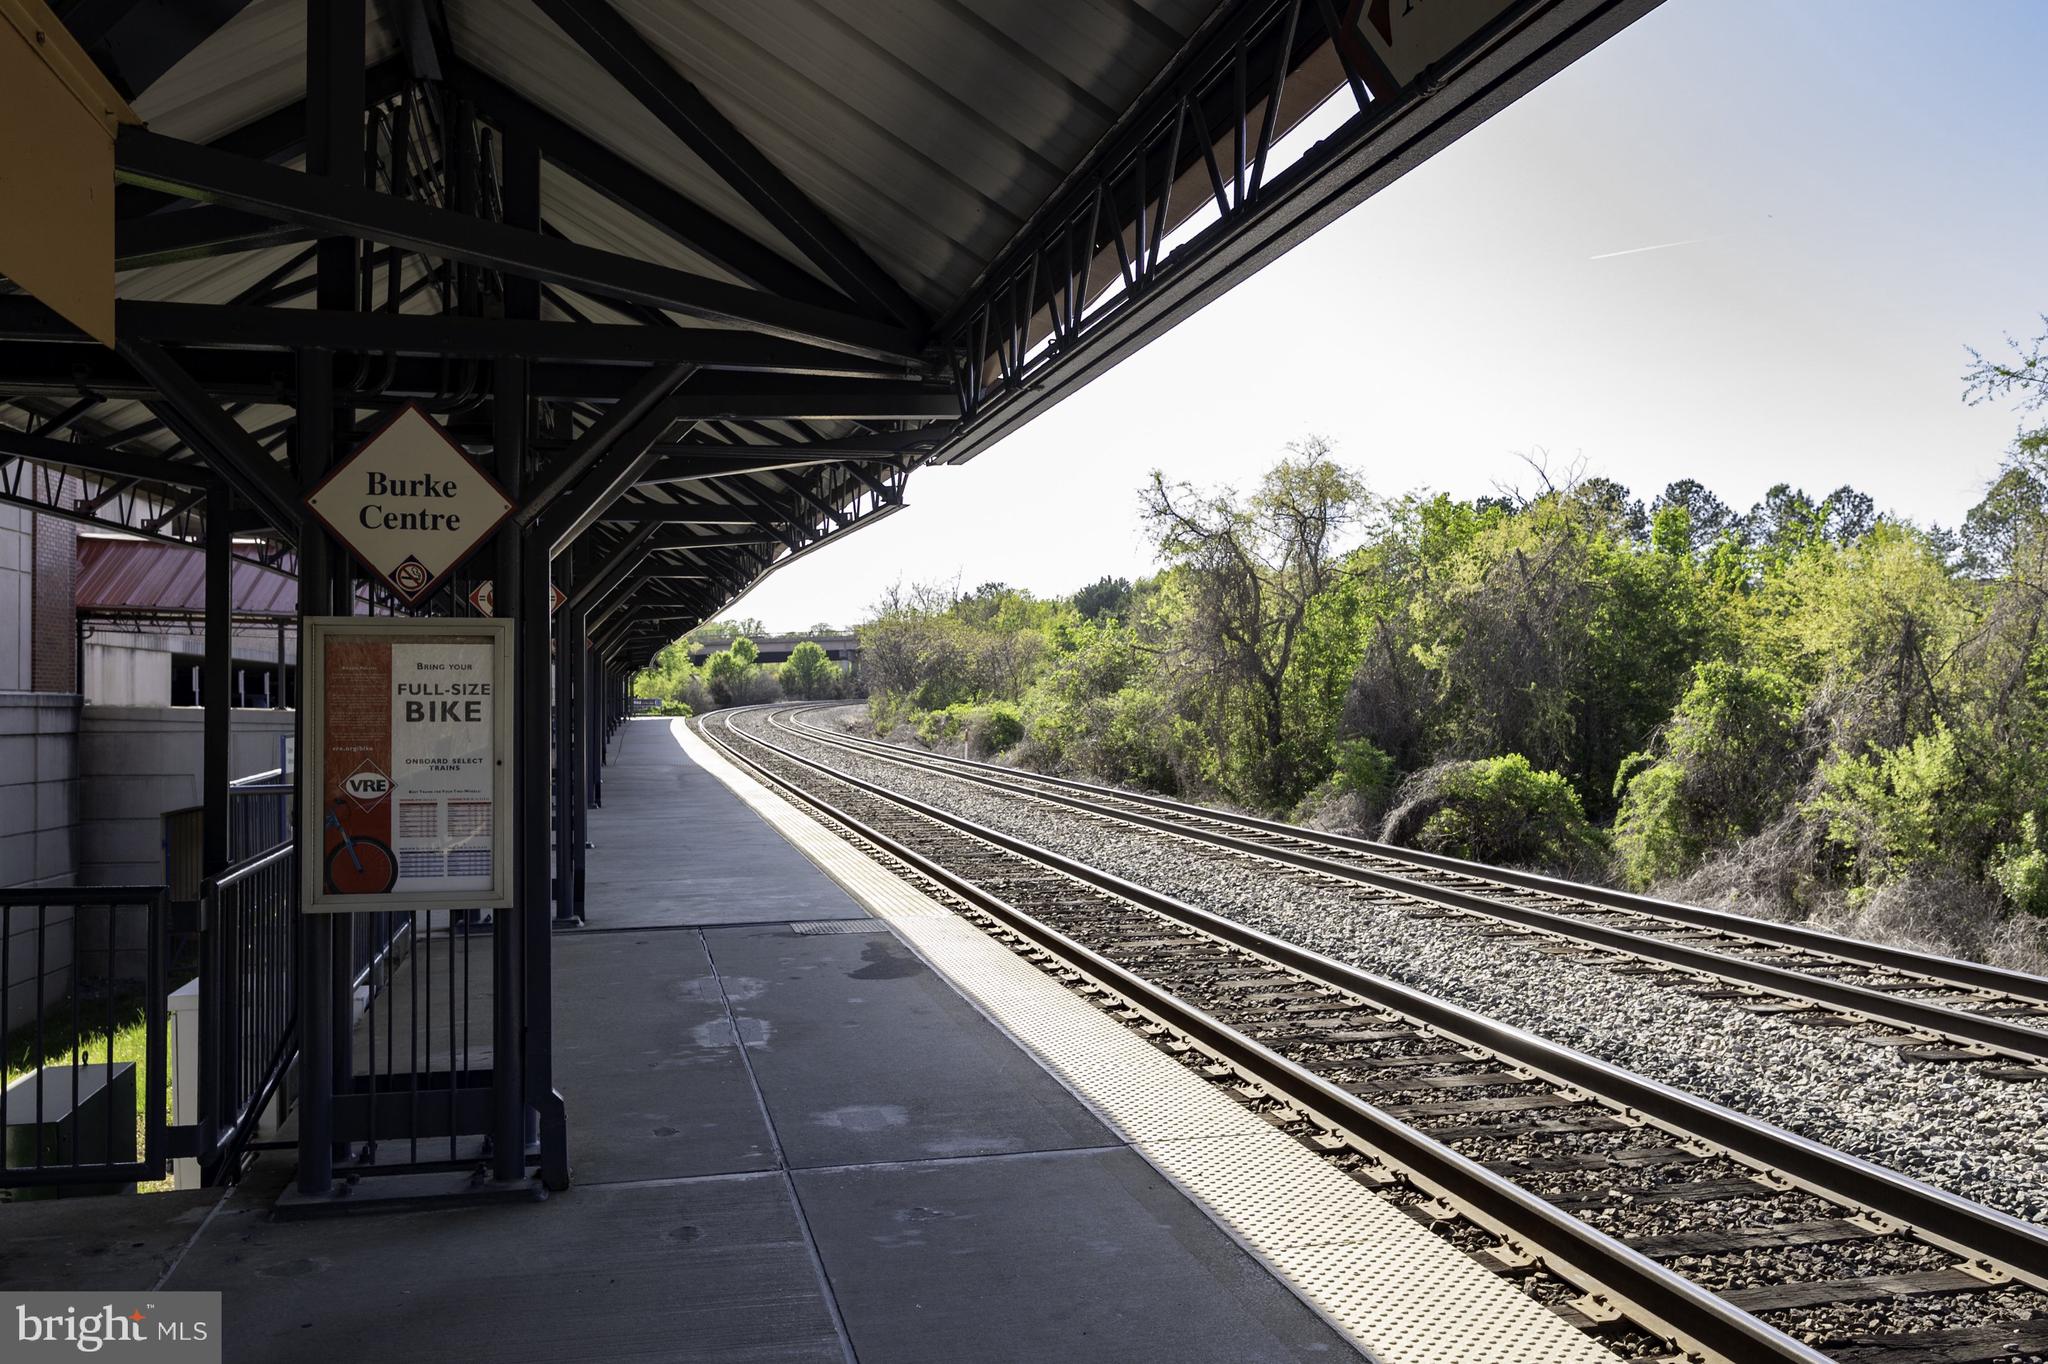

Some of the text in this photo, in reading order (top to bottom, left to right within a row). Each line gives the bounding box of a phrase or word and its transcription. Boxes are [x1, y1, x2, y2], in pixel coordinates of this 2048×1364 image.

[366, 472, 457, 498] Burke
[359, 504, 461, 531] Centre
[416, 662, 473, 671] BRING YOUR
[397, 683, 491, 696] FULL-SIZE
[405, 701, 482, 722] BIKE
[349, 779, 386, 792] VRE
